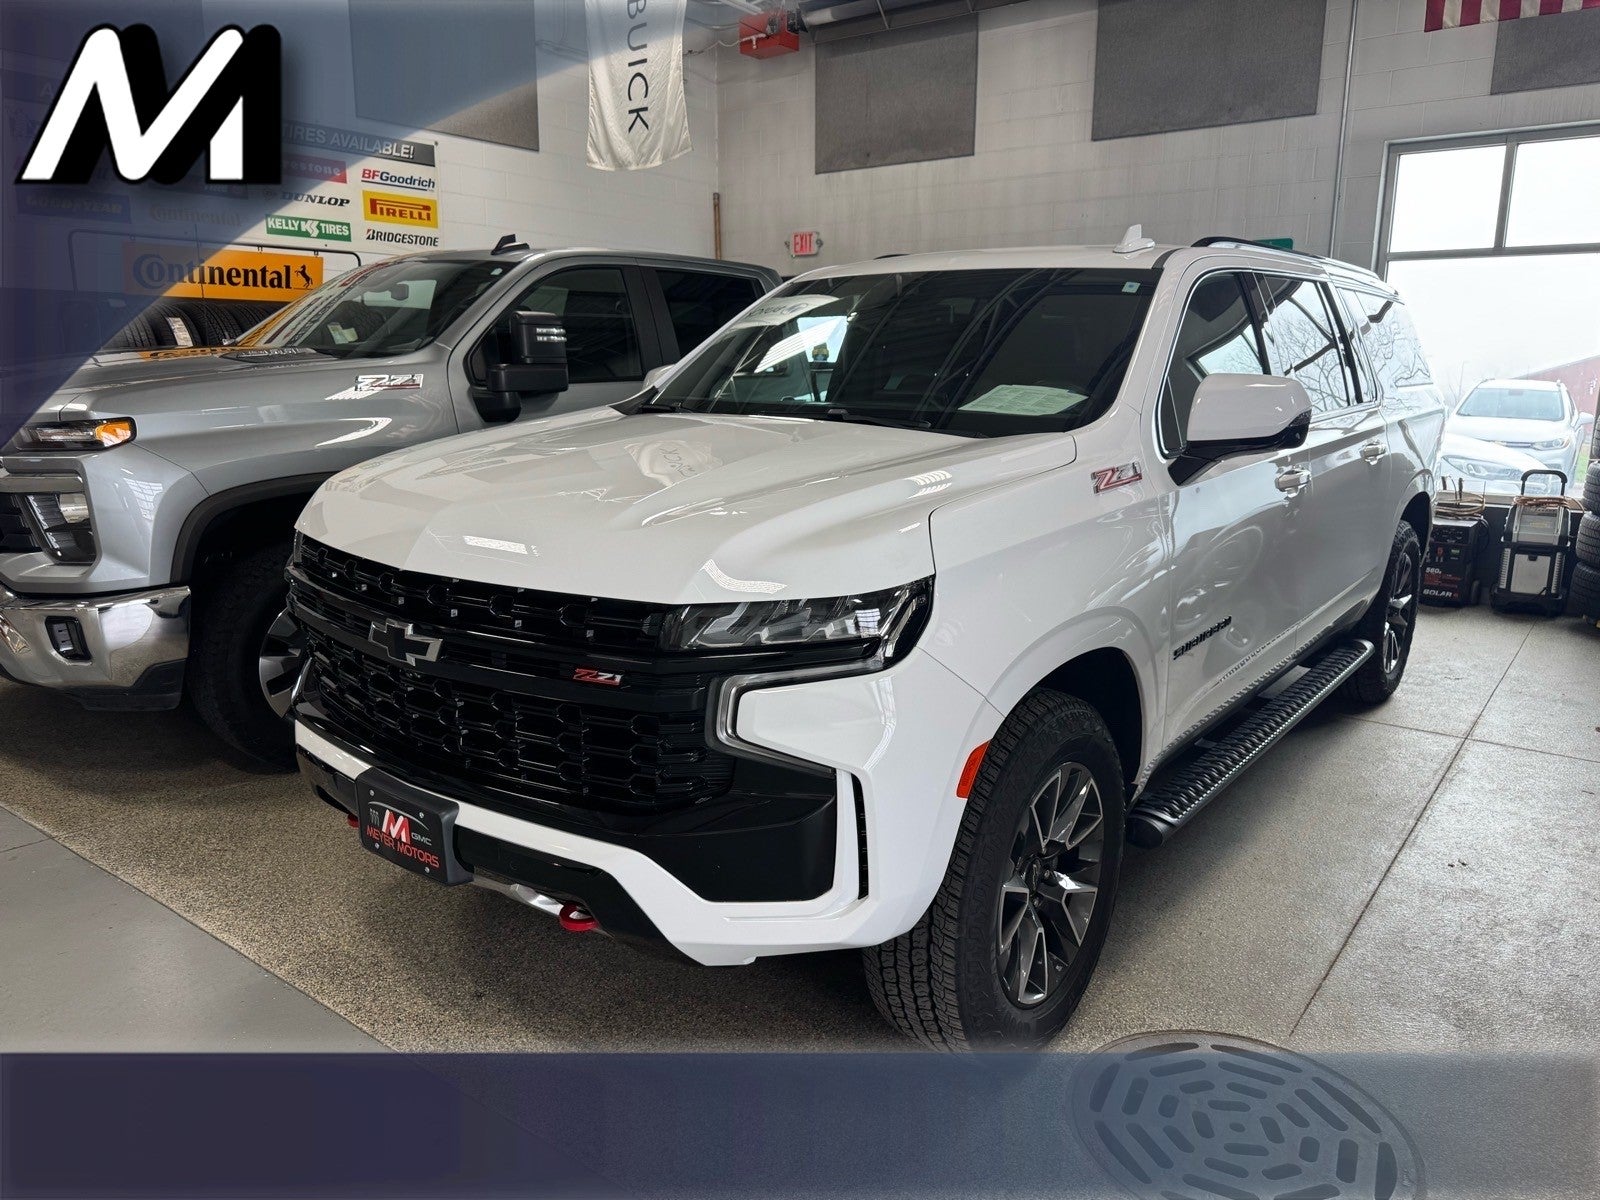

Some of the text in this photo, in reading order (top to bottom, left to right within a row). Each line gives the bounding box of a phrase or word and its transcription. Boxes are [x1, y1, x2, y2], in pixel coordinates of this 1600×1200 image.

[627, 0, 649, 133] BUICK
[330, 132, 415, 159] AVAILABLE!
[361, 168, 436, 190] BFGoodrich
[280, 191, 351, 207] DUNLOP
[369, 197, 431, 222] PIRELLI
[267, 217, 300, 231] KELLY
[320, 223, 350, 236] TIRES
[366, 229, 440, 247] BRIDGESTONE
[793, 232, 813, 254] EXIT
[132, 252, 292, 289] Continental
[354, 374, 424, 391] Z71
[1090, 461, 1143, 494] Z71
[366, 824, 440, 869] MEYER MOTORS
[411, 832, 433, 847] GMC
